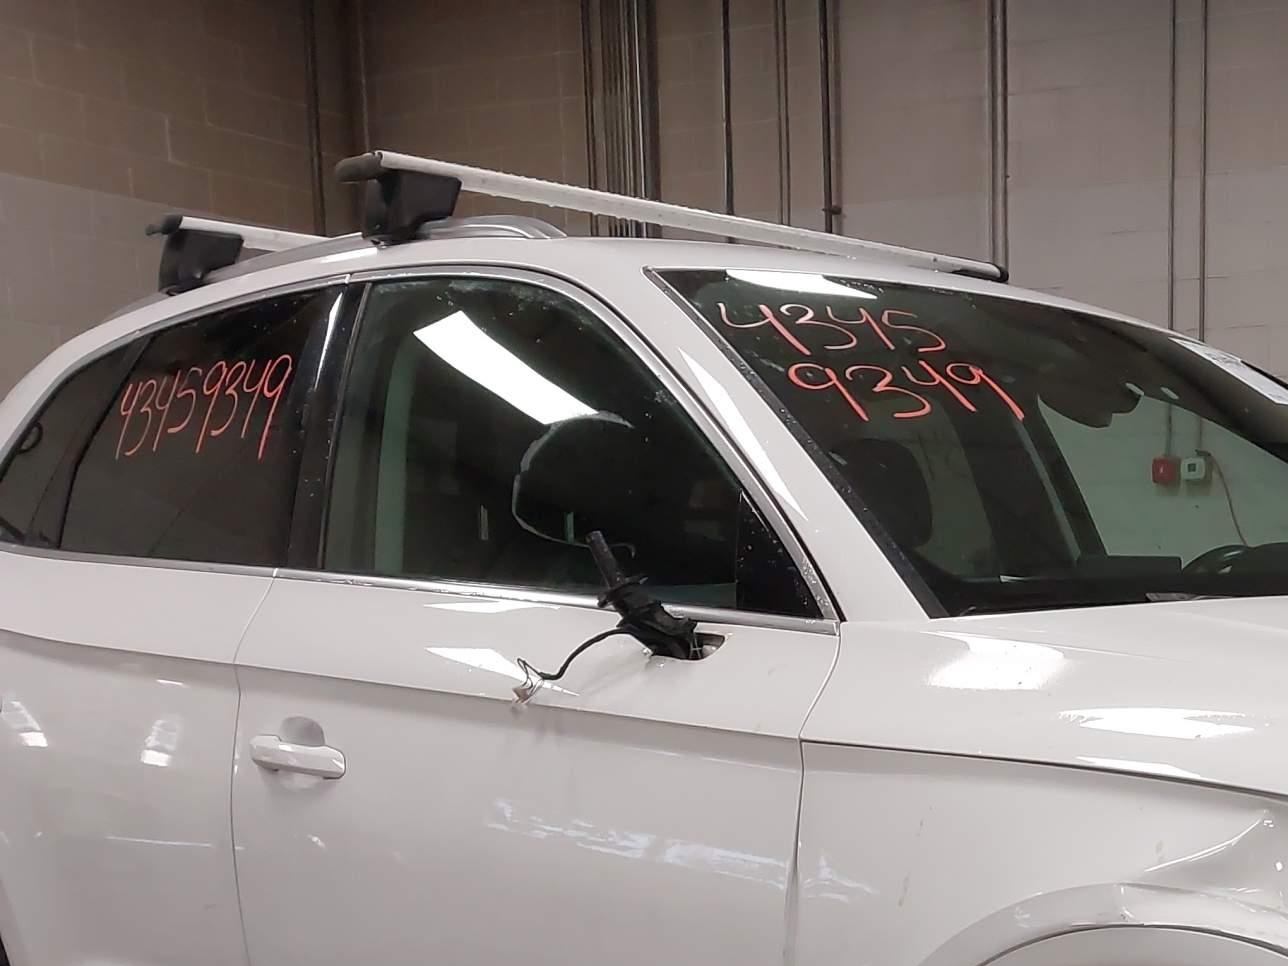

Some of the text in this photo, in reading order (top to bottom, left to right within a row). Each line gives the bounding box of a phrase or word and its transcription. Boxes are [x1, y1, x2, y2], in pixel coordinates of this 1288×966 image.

[718, 301, 946, 357] 4345
[115, 353, 293, 461] 43459349
[786, 359, 1026, 423] 9349
